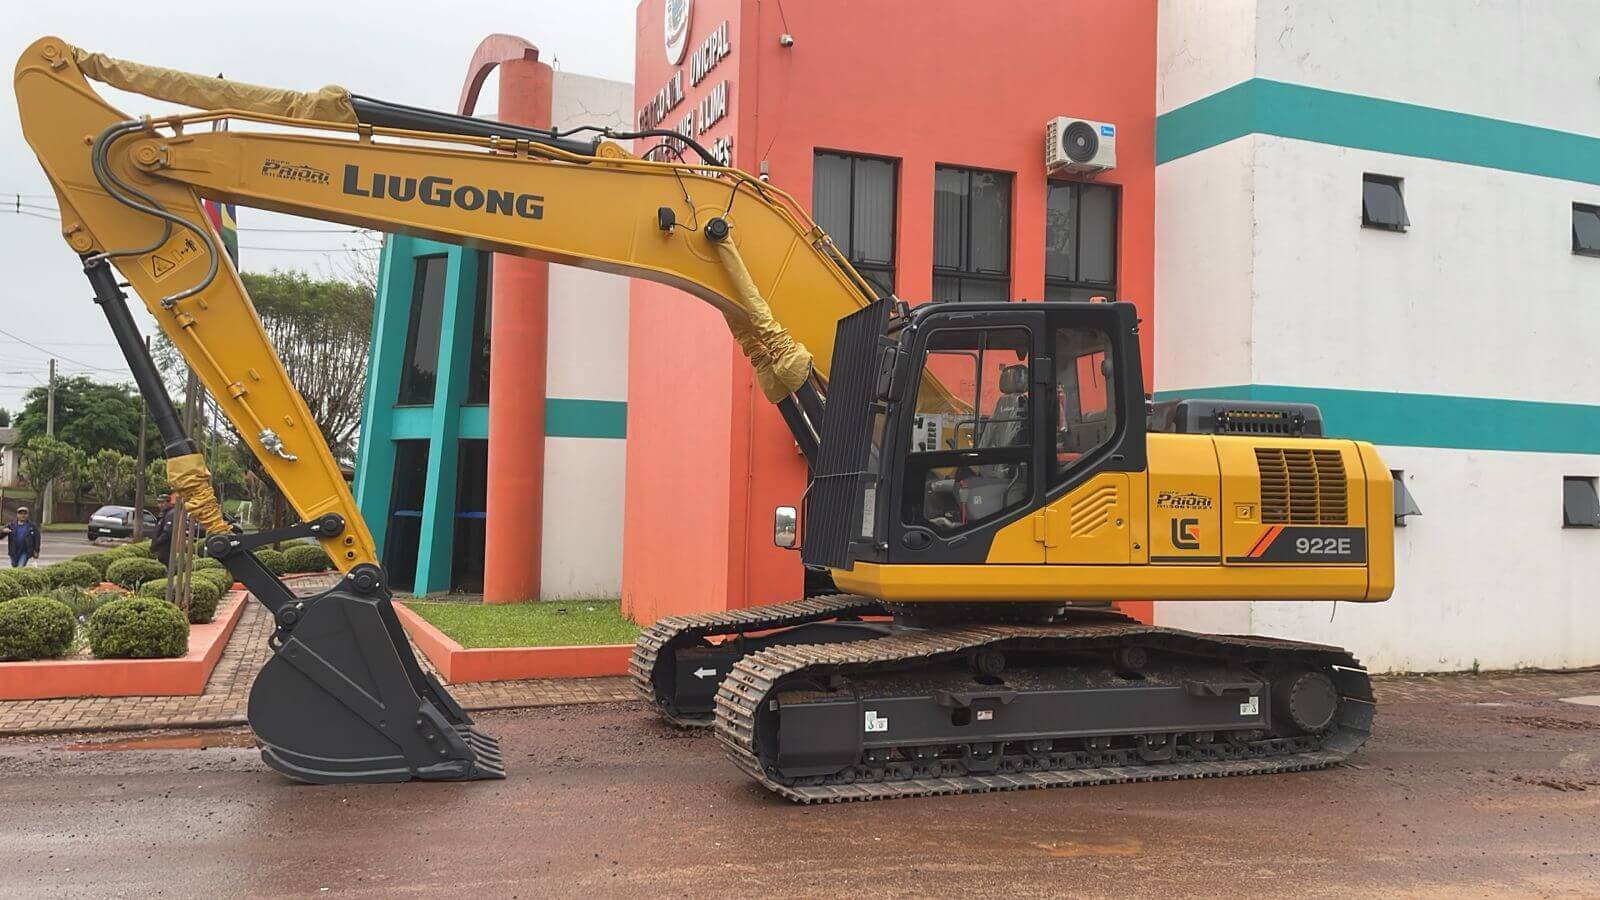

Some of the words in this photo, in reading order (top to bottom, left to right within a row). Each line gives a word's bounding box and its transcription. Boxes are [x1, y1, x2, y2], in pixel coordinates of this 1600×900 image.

[342, 163, 545, 220] LIUGONG
[1157, 493, 1212, 506] PRIORI
[1295, 537, 1352, 554] 922E
